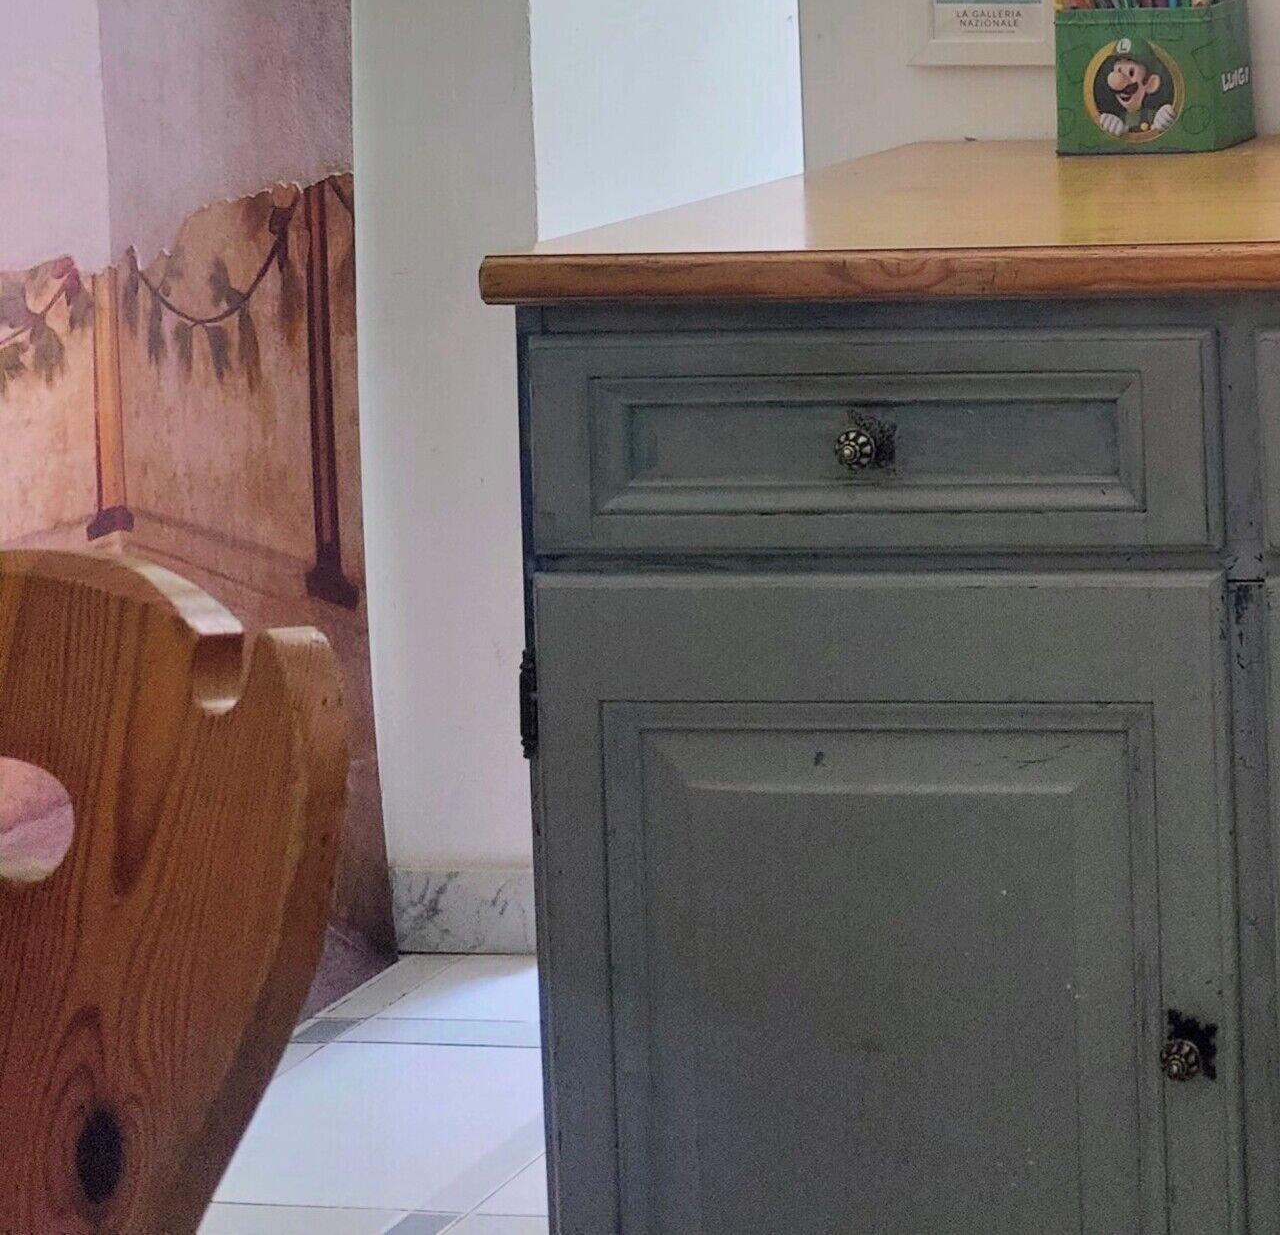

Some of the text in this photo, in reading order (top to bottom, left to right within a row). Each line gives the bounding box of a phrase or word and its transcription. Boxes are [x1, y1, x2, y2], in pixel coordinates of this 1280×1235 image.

[956, 8, 1023, 19] LA GALLERIA
[959, 18, 1020, 29] NAZIONALE
[1220, 65, 1250, 93] LUIGI
